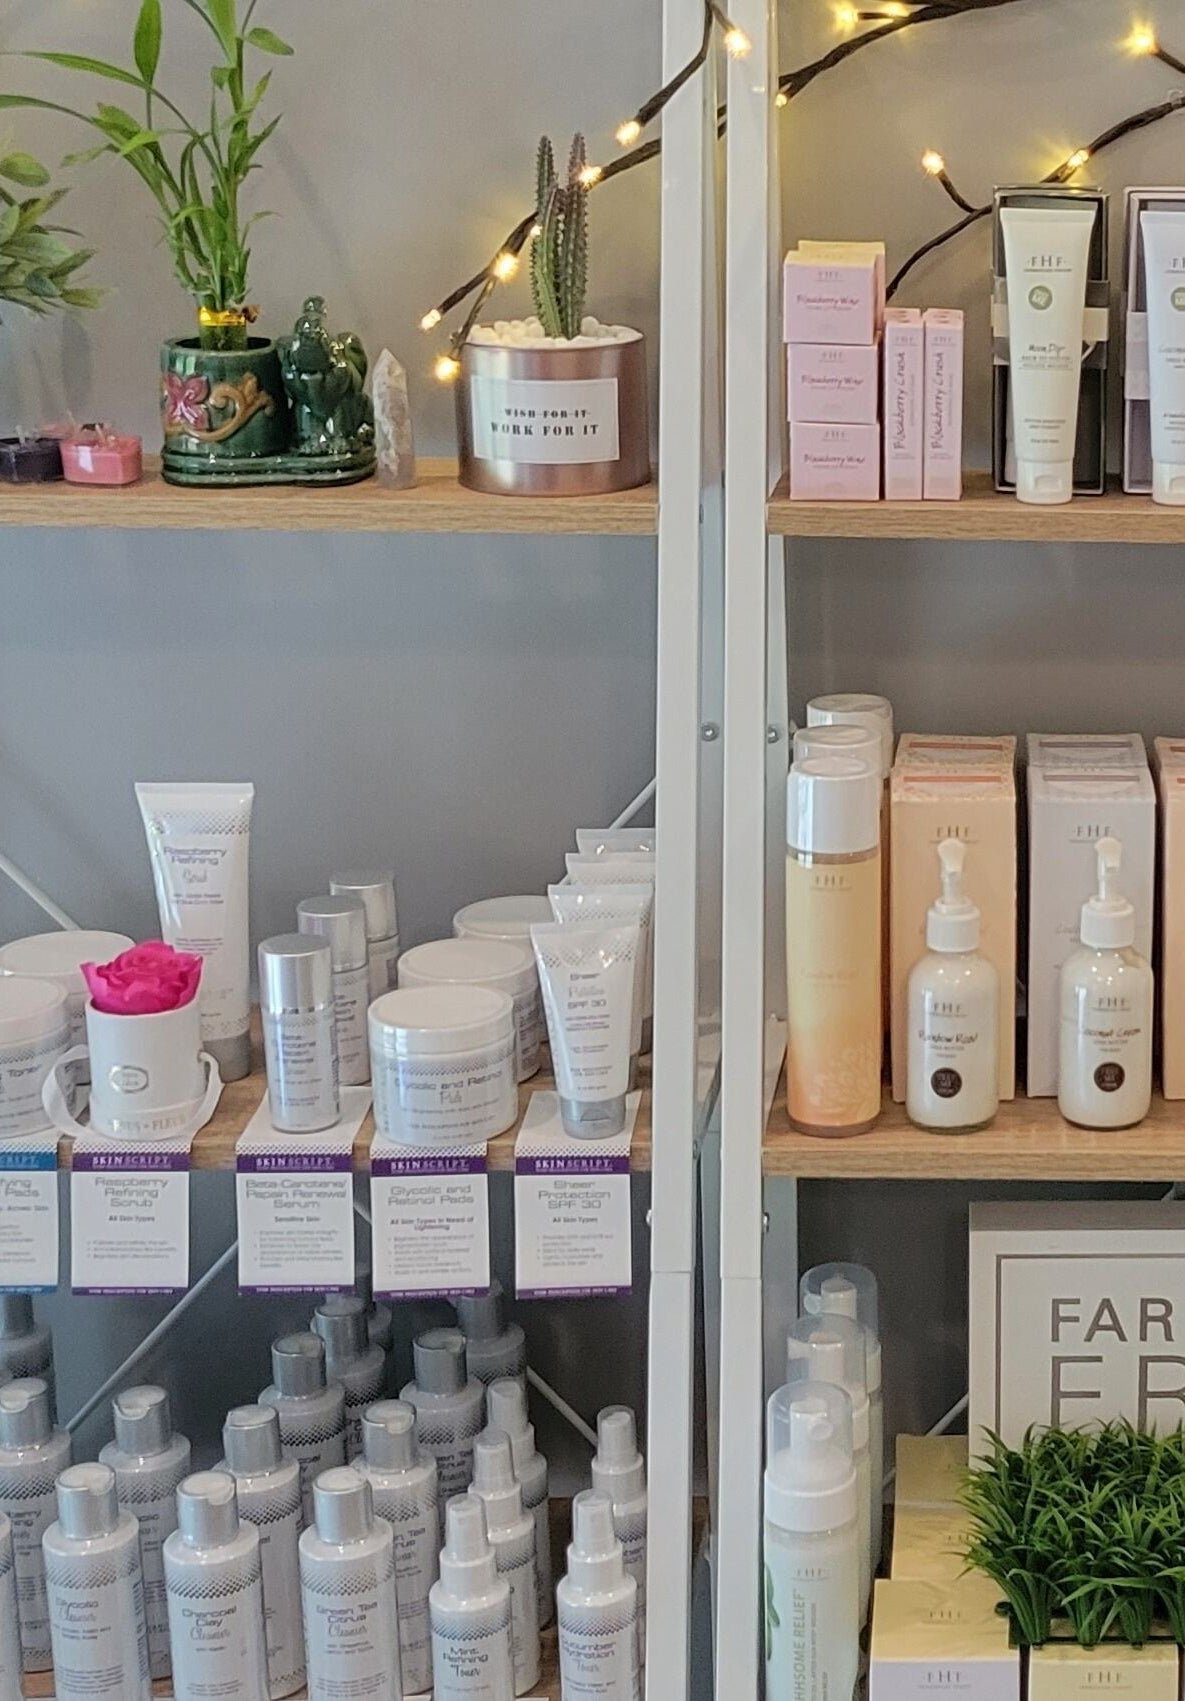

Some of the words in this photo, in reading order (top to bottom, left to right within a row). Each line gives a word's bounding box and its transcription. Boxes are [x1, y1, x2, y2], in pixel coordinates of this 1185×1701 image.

[1032, 256, 1063, 268] FHF
[504, 408, 535, 419] WISH
[543, 410, 568, 419] FOR
[574, 409, 588, 418] IT
[490, 421, 533, 436] WORK
[543, 425, 574, 436] FOR
[583, 424, 599, 436] IT
[7, 1064, 42, 1078] Toner
[440, 1078, 464, 1089] and
[95, 1177, 169, 1189] Raspberry
[246, 1180, 278, 1189] Beta
[553, 1180, 596, 1190] Sheer
[5, 1188, 40, 1198] Pads
[104, 1187, 159, 1199] Refining
[245, 1190, 289, 1200] Repair
[292, 1189, 347, 1199] Renewal
[390, 1185, 442, 1197] Glycolic
[446, 1184, 472, 1194] and
[538, 1190, 612, 1201] Protection
[110, 1197, 153, 1208] Scrub
[273, 1200, 321, 1209] Serum
[388, 1196, 436, 1206] Retinol
[440, 1194, 475, 1204] Pads
[548, 1200, 577, 1210] SPF
[581, 1200, 602, 1210] 30
[181, 1606, 237, 1618] Charcoal
[358, 1601, 378, 1612] Tea
[195, 1618, 224, 1628] Clay
[450, 1646, 480, 1655] Mint
